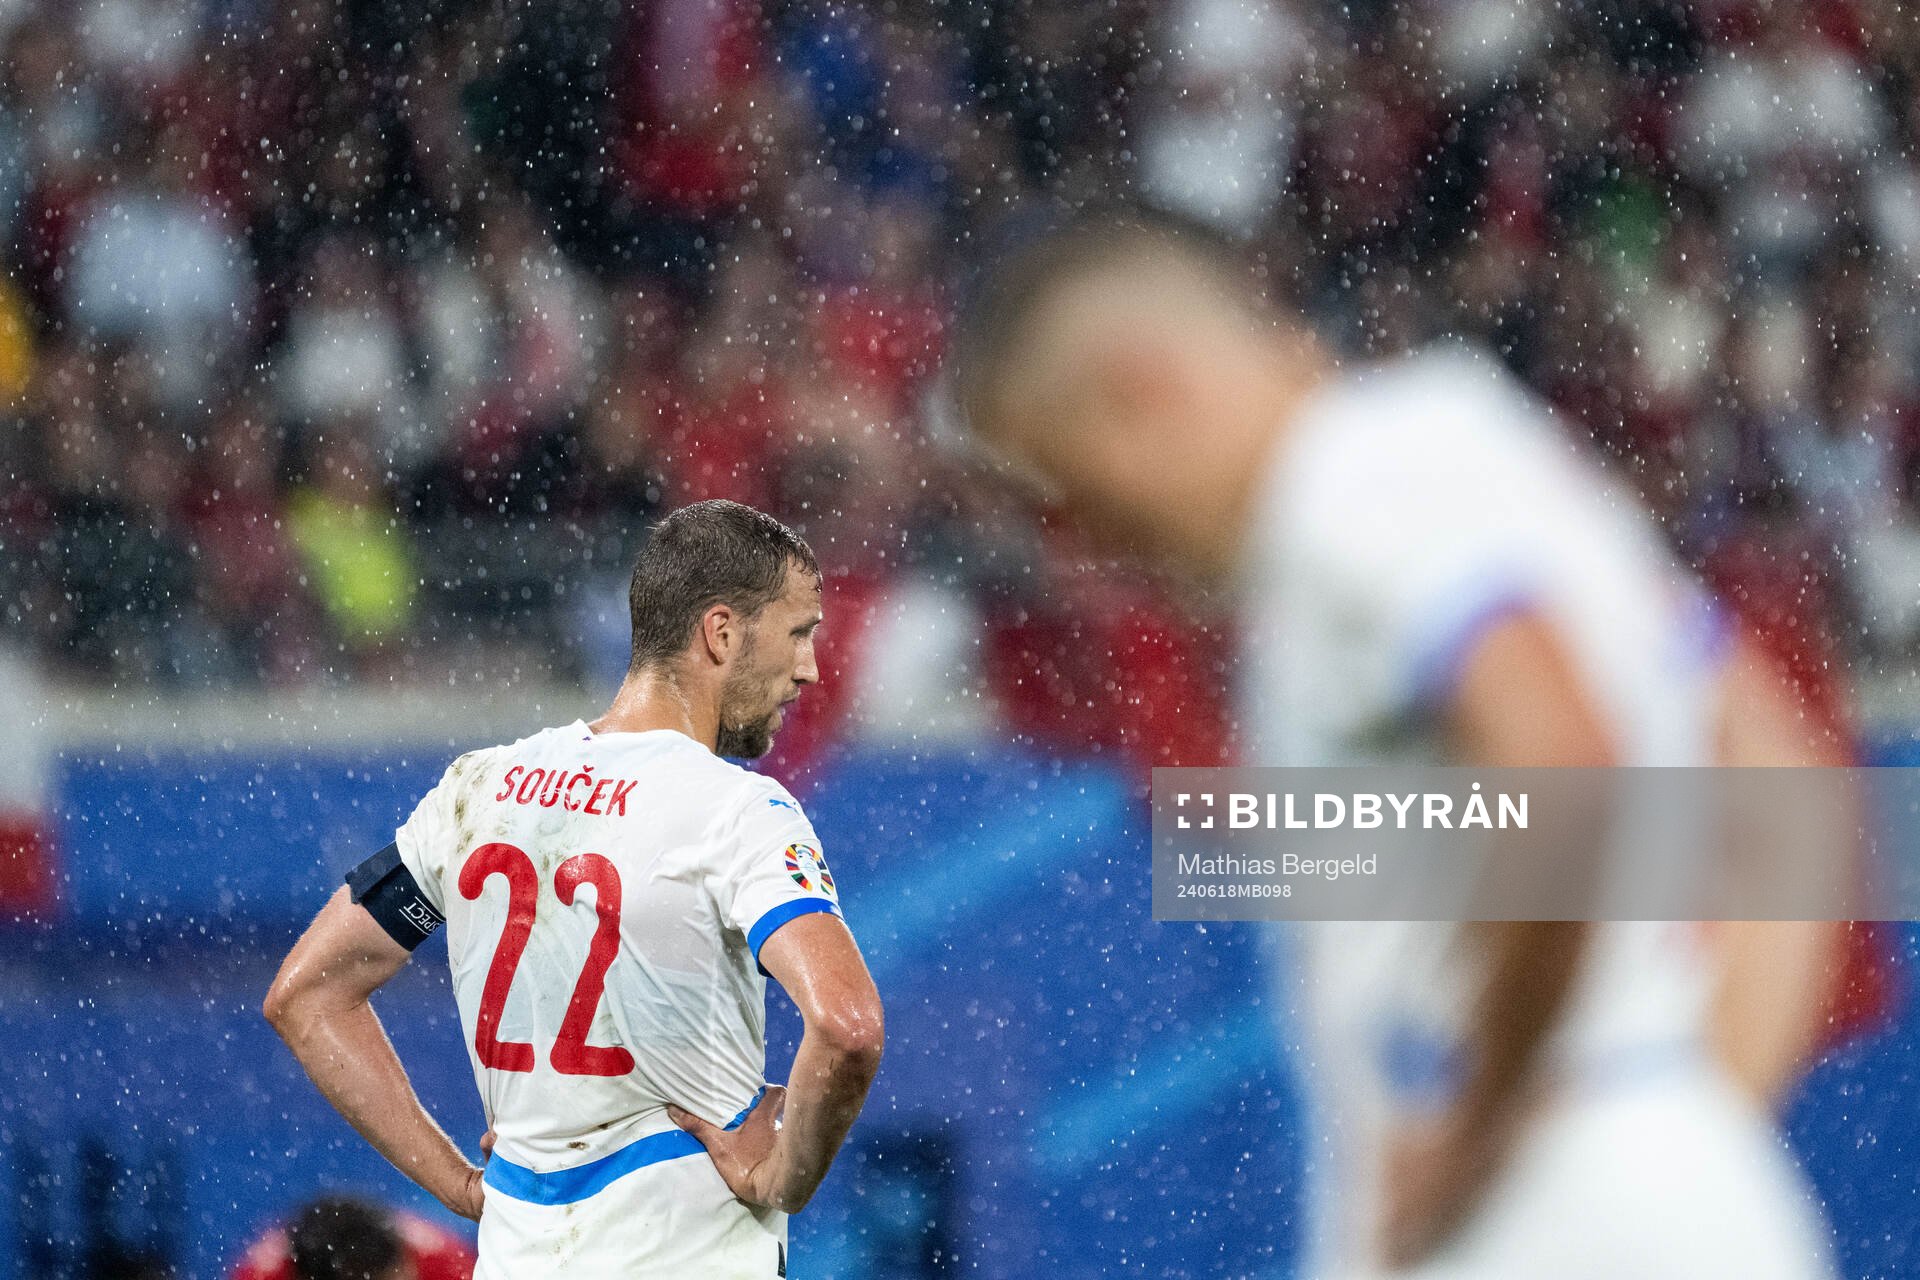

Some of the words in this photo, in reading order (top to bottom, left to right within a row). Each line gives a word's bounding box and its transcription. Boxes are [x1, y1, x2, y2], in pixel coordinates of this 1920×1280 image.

[496, 765, 638, 816] SOUČEK
[403, 902, 440, 932] SPECT
[459, 843, 634, 1076] 22
